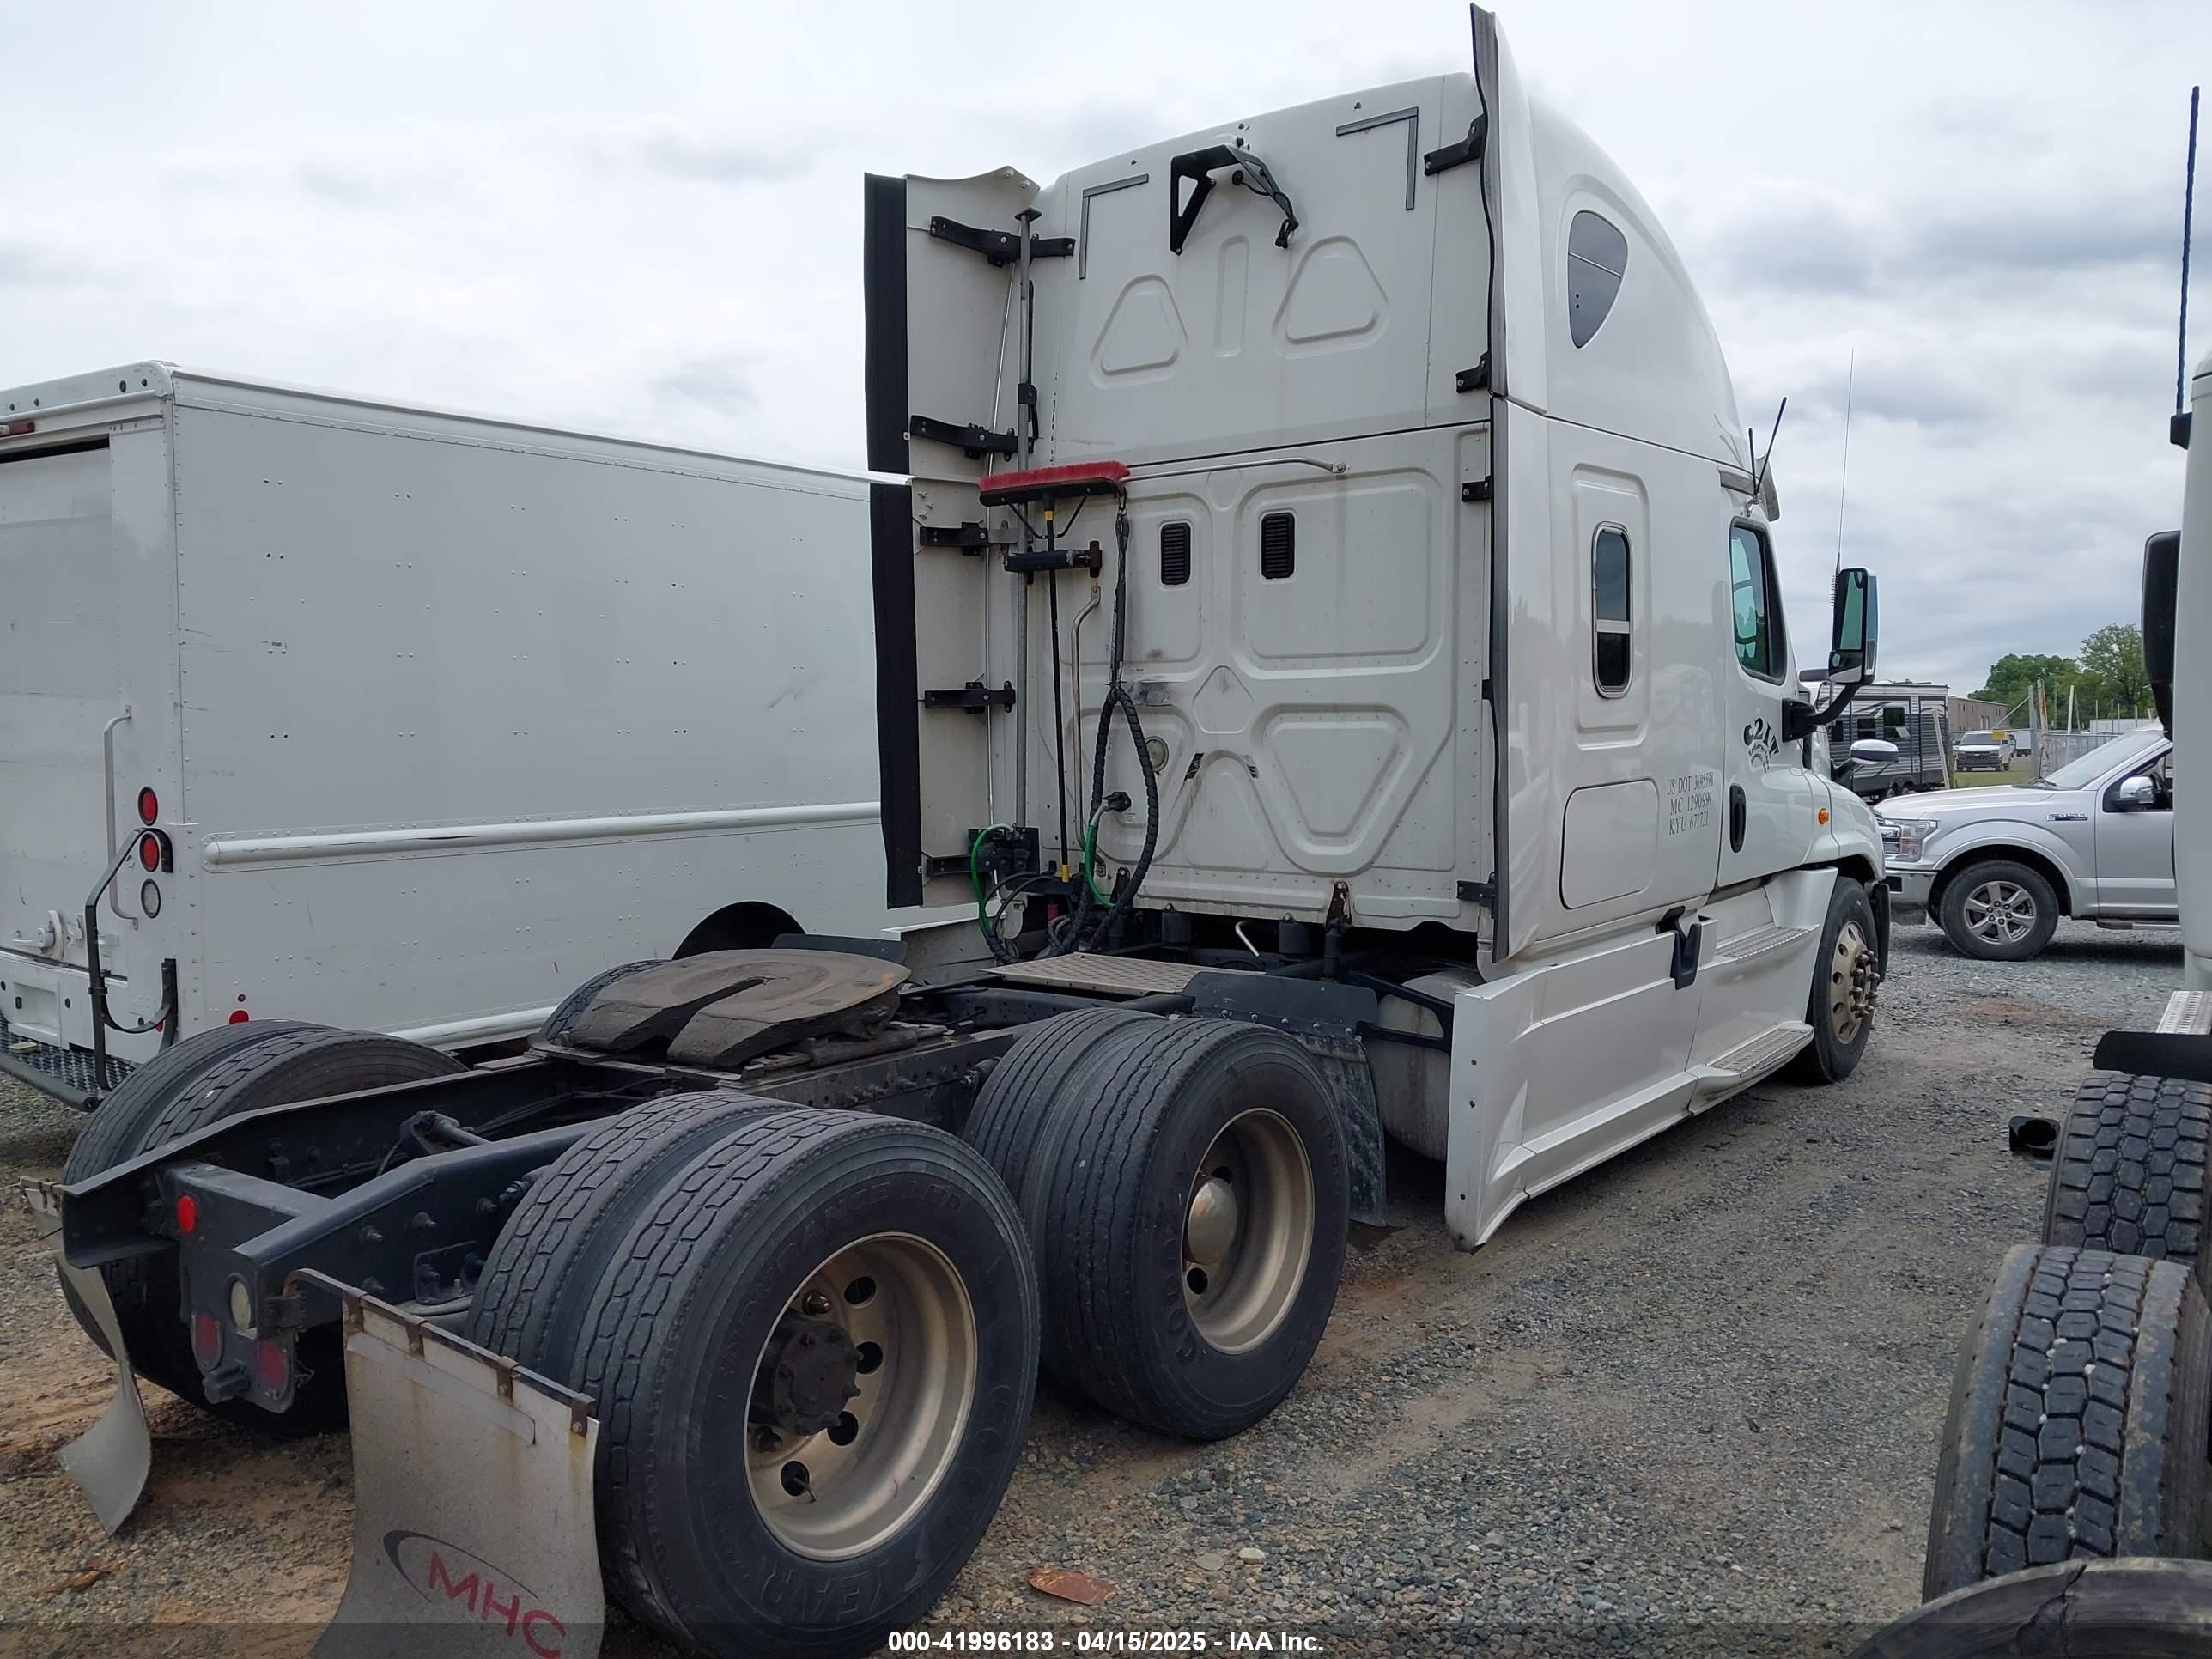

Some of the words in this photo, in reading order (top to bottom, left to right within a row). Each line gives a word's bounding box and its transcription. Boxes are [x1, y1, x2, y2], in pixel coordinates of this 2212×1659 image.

[1668, 779, 1676, 794] US
[1678, 775, 1692, 793] DOT
[1670, 797, 1684, 815] MC
[1668, 816, 1687, 835] KYU
[428, 1550, 567, 1659] MHC
